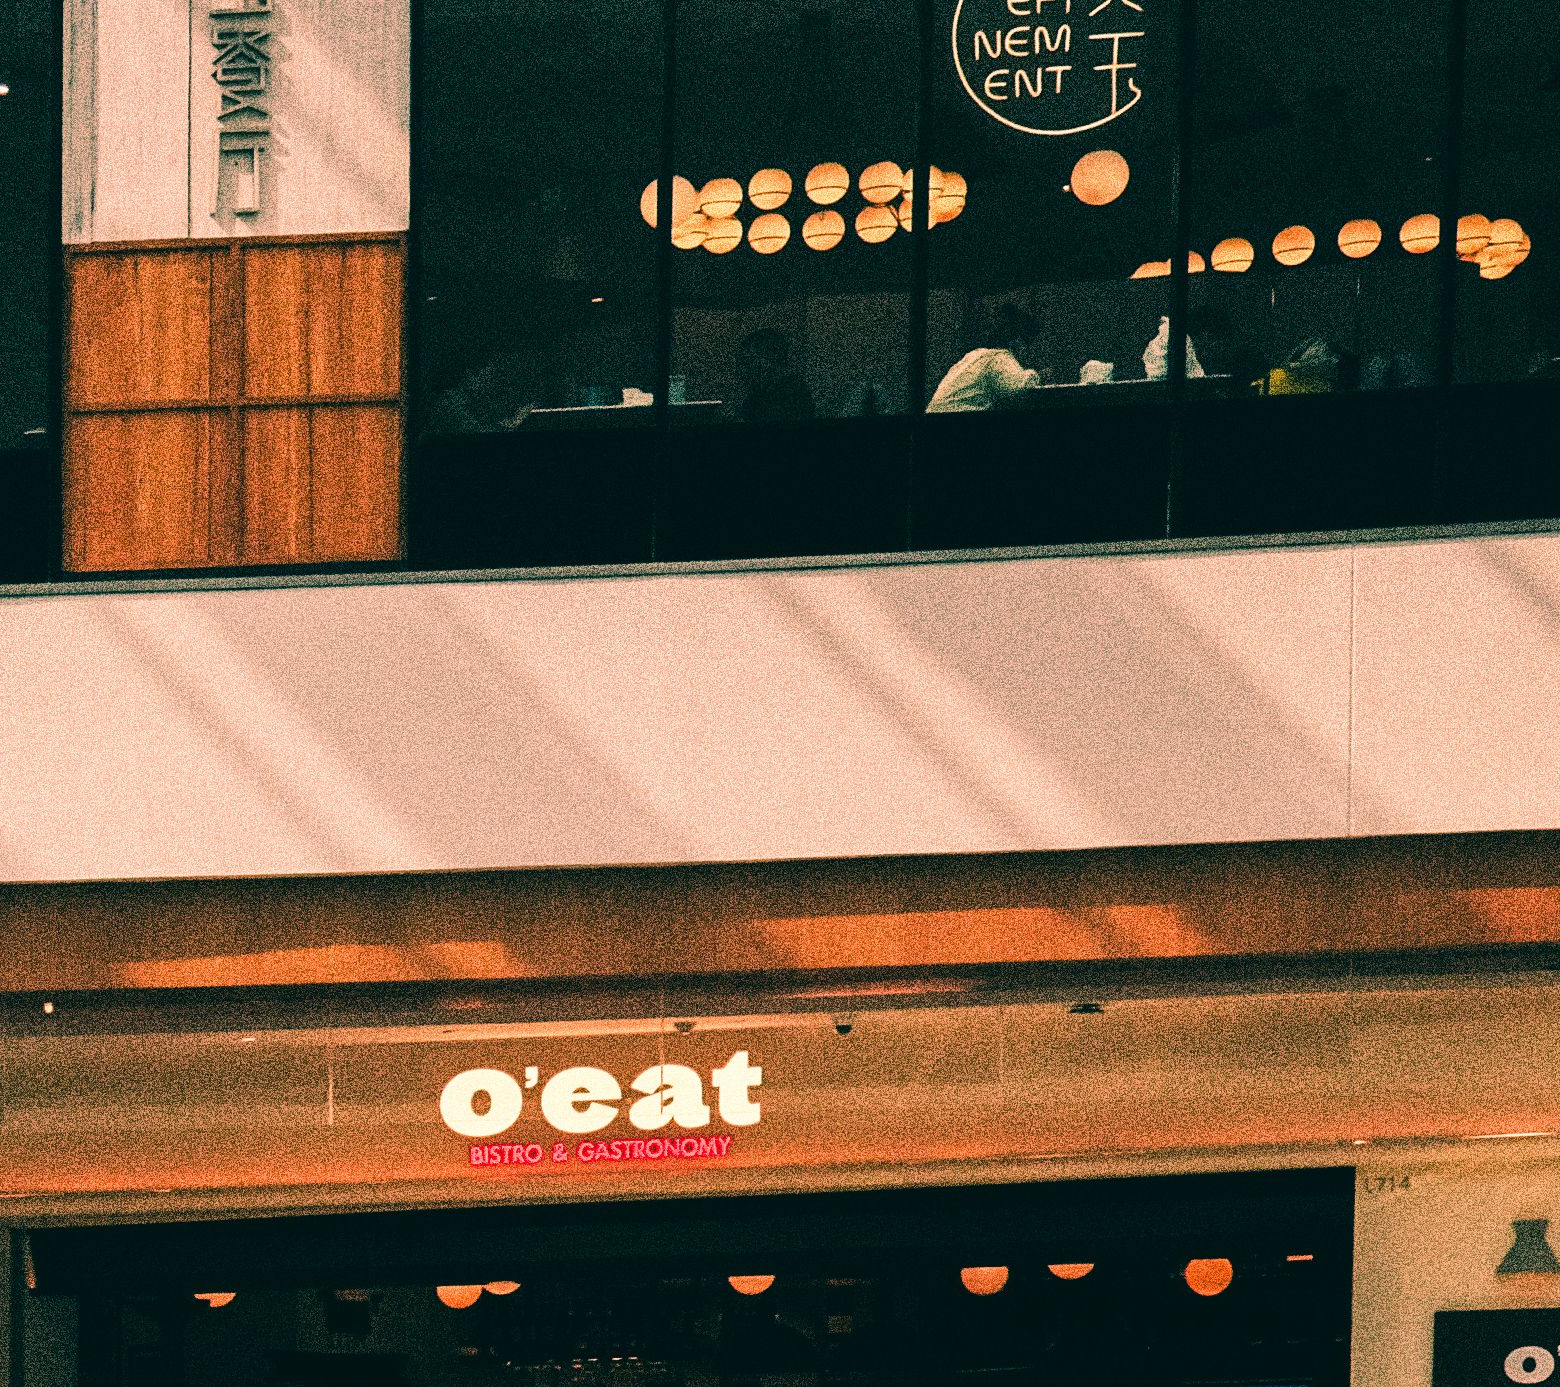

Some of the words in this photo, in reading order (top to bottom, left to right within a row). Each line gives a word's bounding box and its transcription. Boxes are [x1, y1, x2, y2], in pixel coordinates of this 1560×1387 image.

[973, 24, 1072, 61] NEM
[983, 65, 1073, 101] ENT
[470, 1143, 543, 1167] BISTRO
[551, 1142, 568, 1163] &
[577, 1136, 732, 1163] GASTRONOMY
